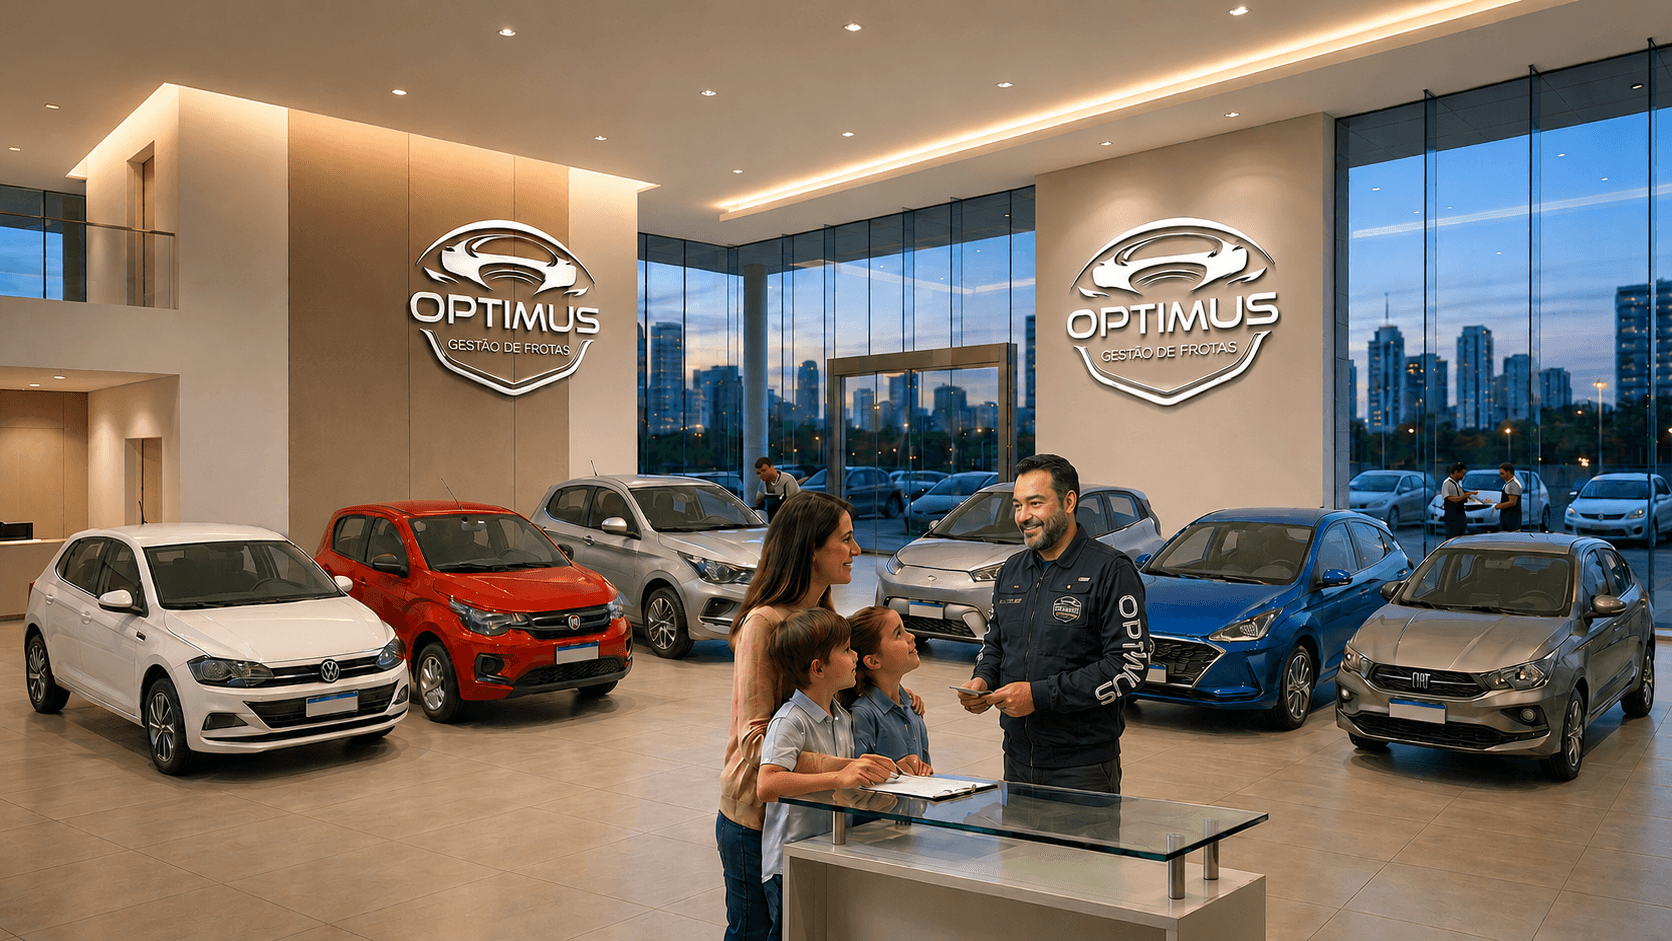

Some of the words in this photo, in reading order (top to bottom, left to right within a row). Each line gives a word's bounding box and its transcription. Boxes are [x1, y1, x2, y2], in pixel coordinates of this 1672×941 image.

[410, 291, 600, 334] OPTIMUS
[1066, 292, 1279, 340] OPTIMUS
[448, 338, 500, 353] GESTÃO
[504, 342, 521, 354] DE
[524, 343, 570, 356] FROTAS
[1101, 346, 1153, 362] GESTÃO
[1157, 345, 1175, 358] DE
[1180, 342, 1237, 357] FROTAS
[1095, 594, 1147, 705] OPTIMUS
